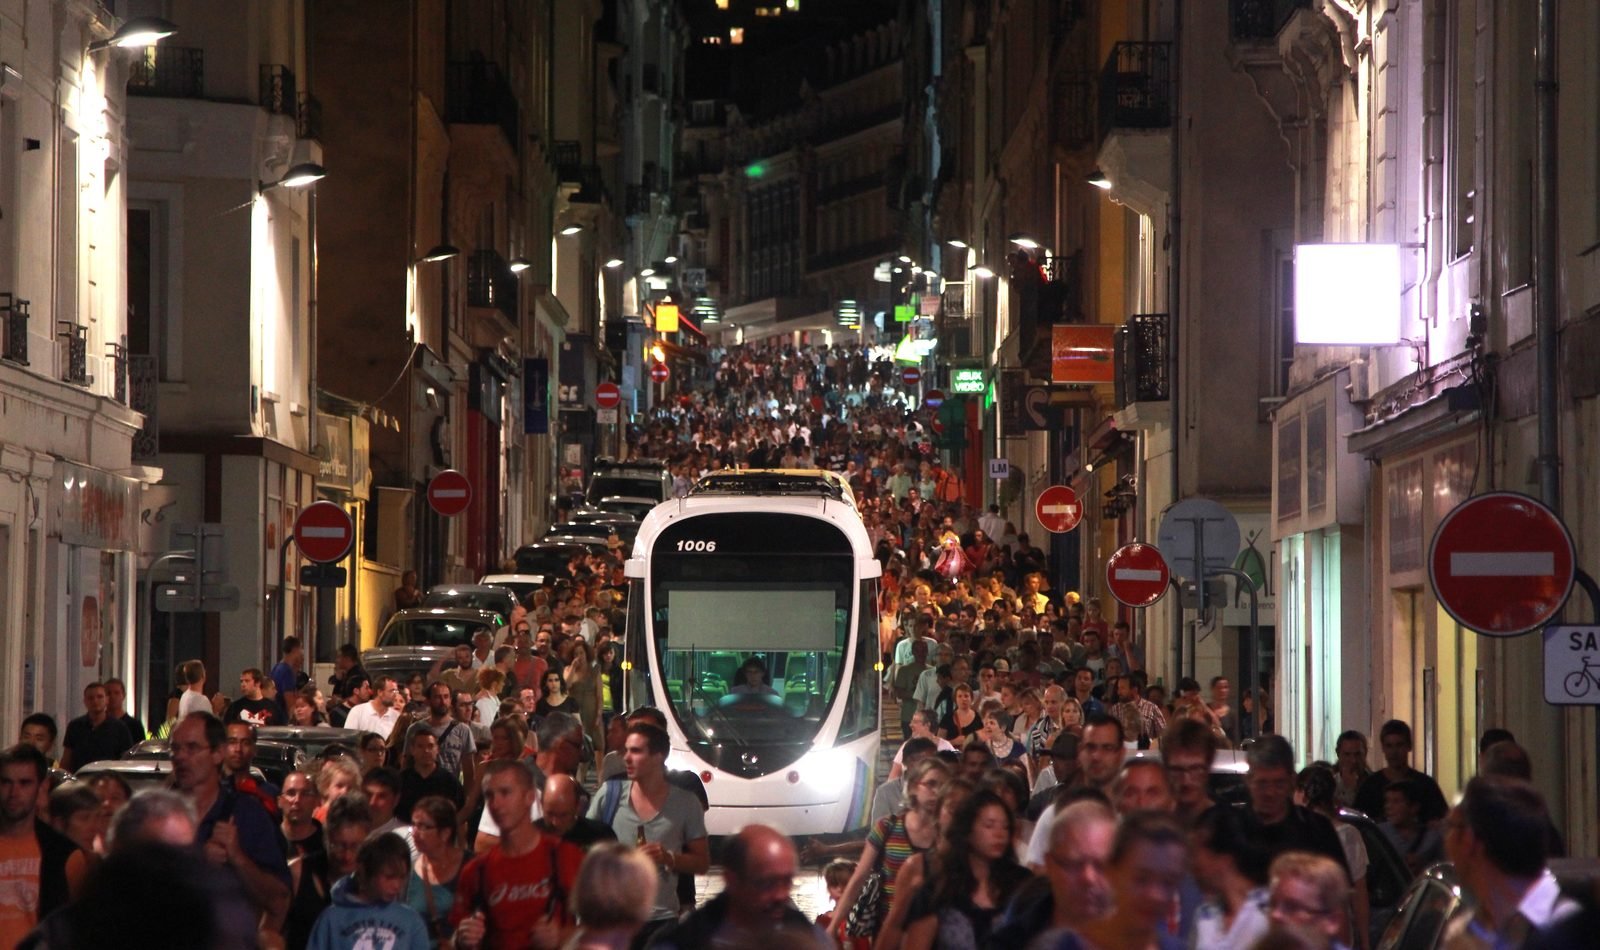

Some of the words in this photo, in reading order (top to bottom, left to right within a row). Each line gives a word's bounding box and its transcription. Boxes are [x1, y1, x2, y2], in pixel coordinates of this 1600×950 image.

[956, 371, 982, 380] JEUX
[992, 463, 1007, 473] LM
[676, 539, 717, 553] 1006
[1569, 631, 1599, 651] SA
